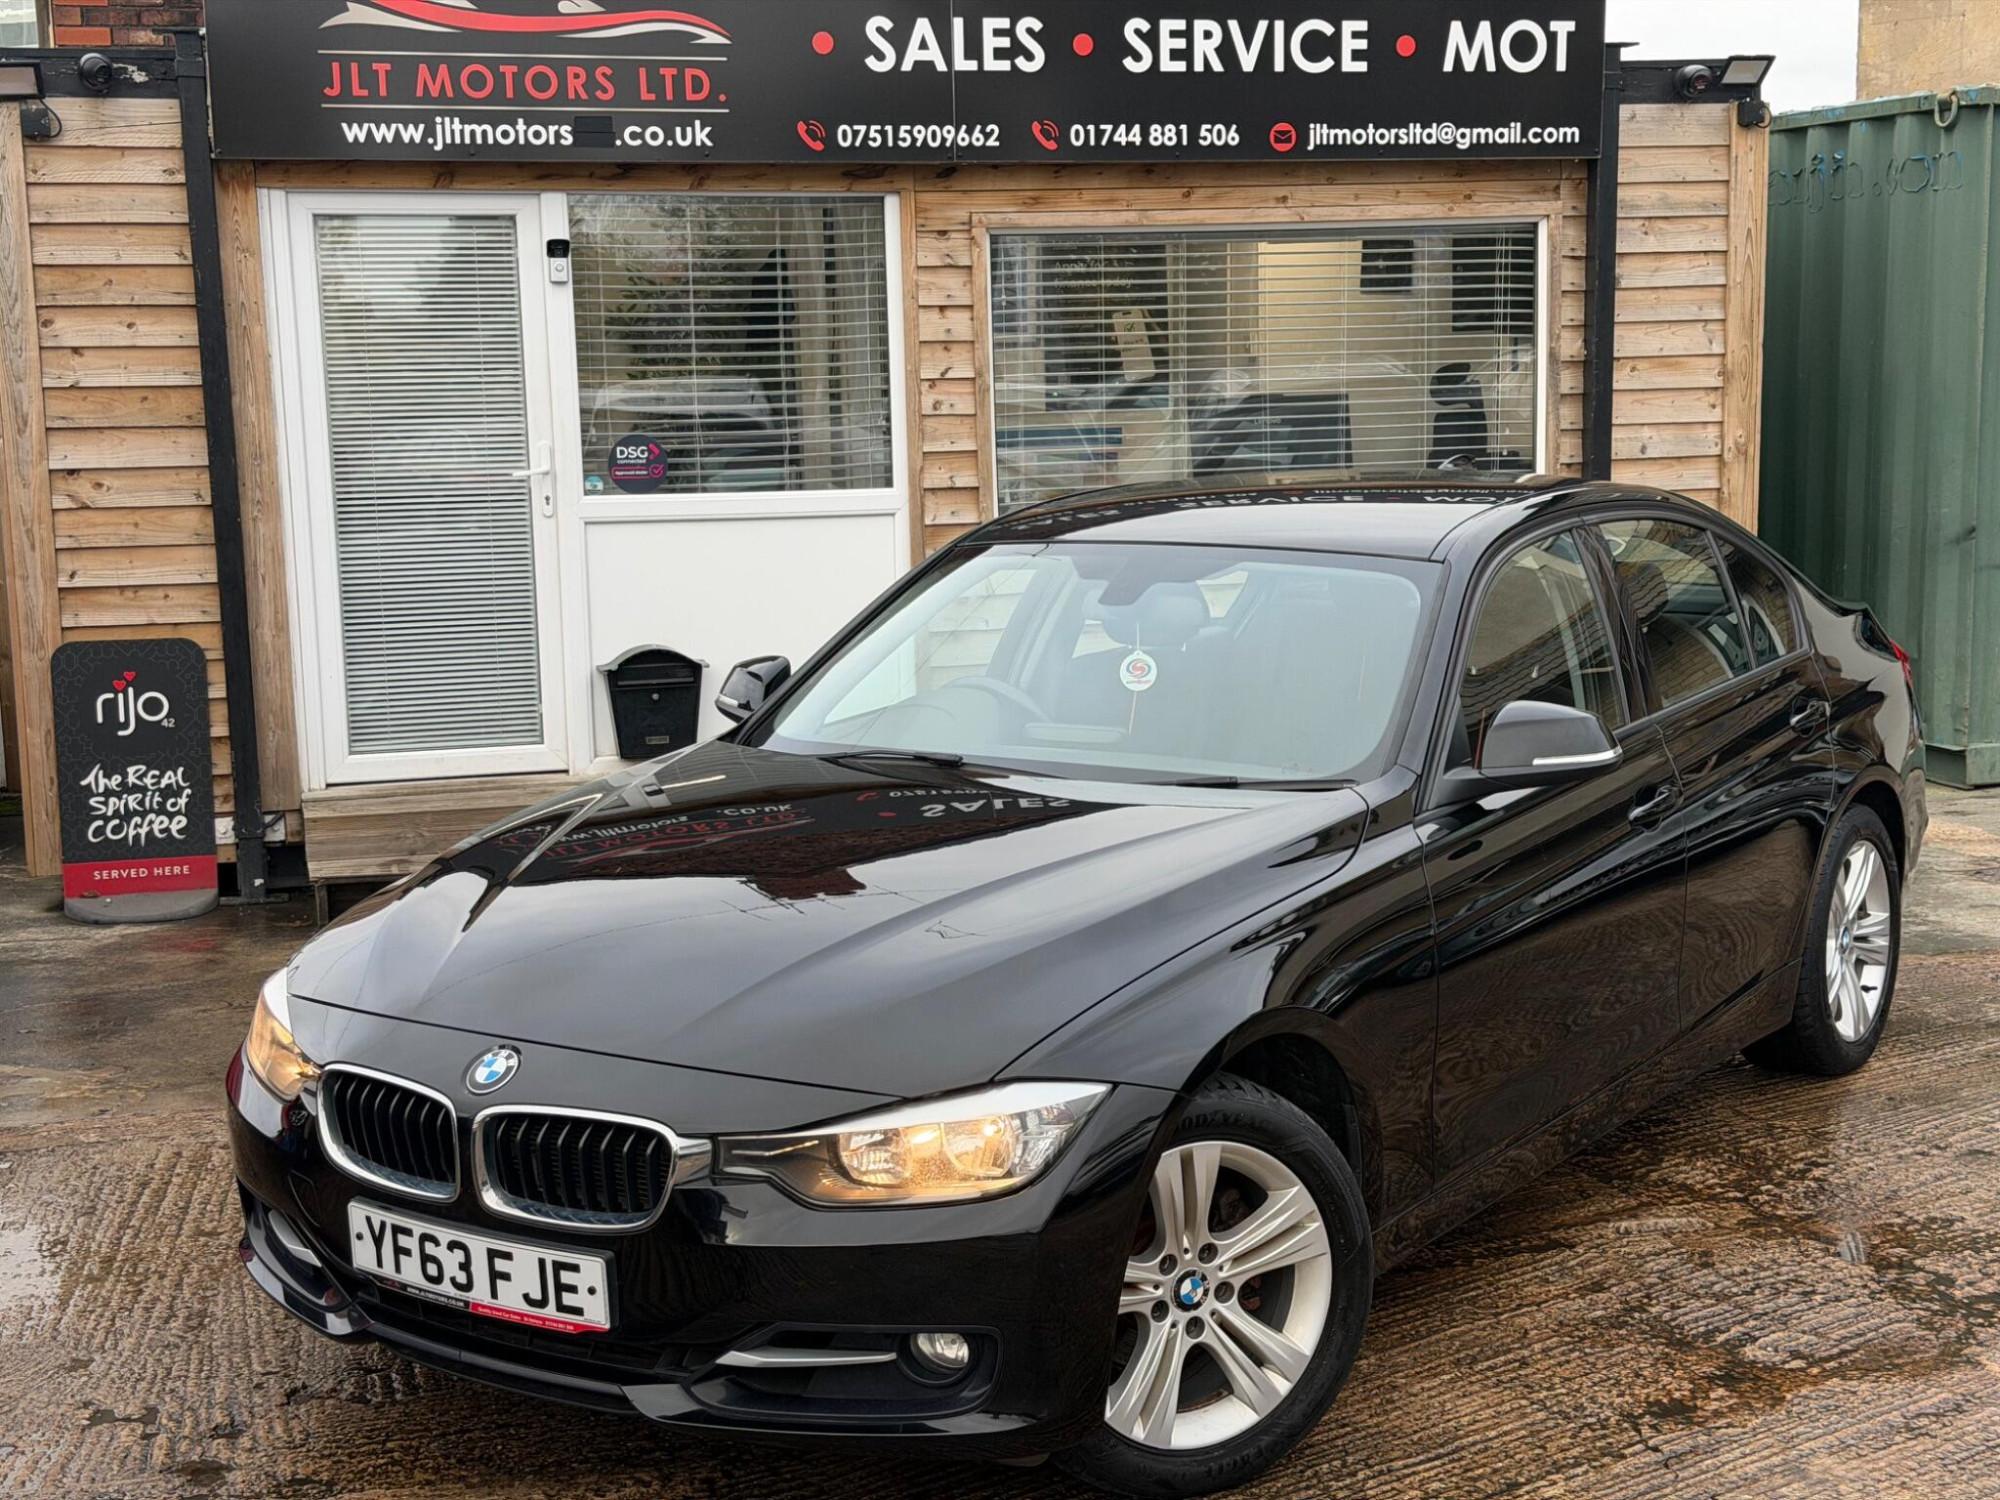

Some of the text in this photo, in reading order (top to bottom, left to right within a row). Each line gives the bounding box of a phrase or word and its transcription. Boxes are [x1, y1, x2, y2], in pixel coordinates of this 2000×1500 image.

[864, 15, 1046, 73] SALES
[1122, 17, 1369, 73] SERVICE
[1442, 19, 1576, 73] MOT
[322, 61, 728, 102] JLT MOTORS LTD.
[836, 123, 1000, 149] 07515909662
[1069, 123, 1240, 148] 01744 881 506
[1307, 121, 1581, 150] jltmotorsltd@gmail.com
[616, 446, 648, 458] DSG
[160, 718, 176, 728] 42
[79, 763, 122, 793] The
[165, 788, 193, 815] of
[93, 865, 191, 880] SERVED HERE
[364, 1214, 585, 1317] YF63 FJE
